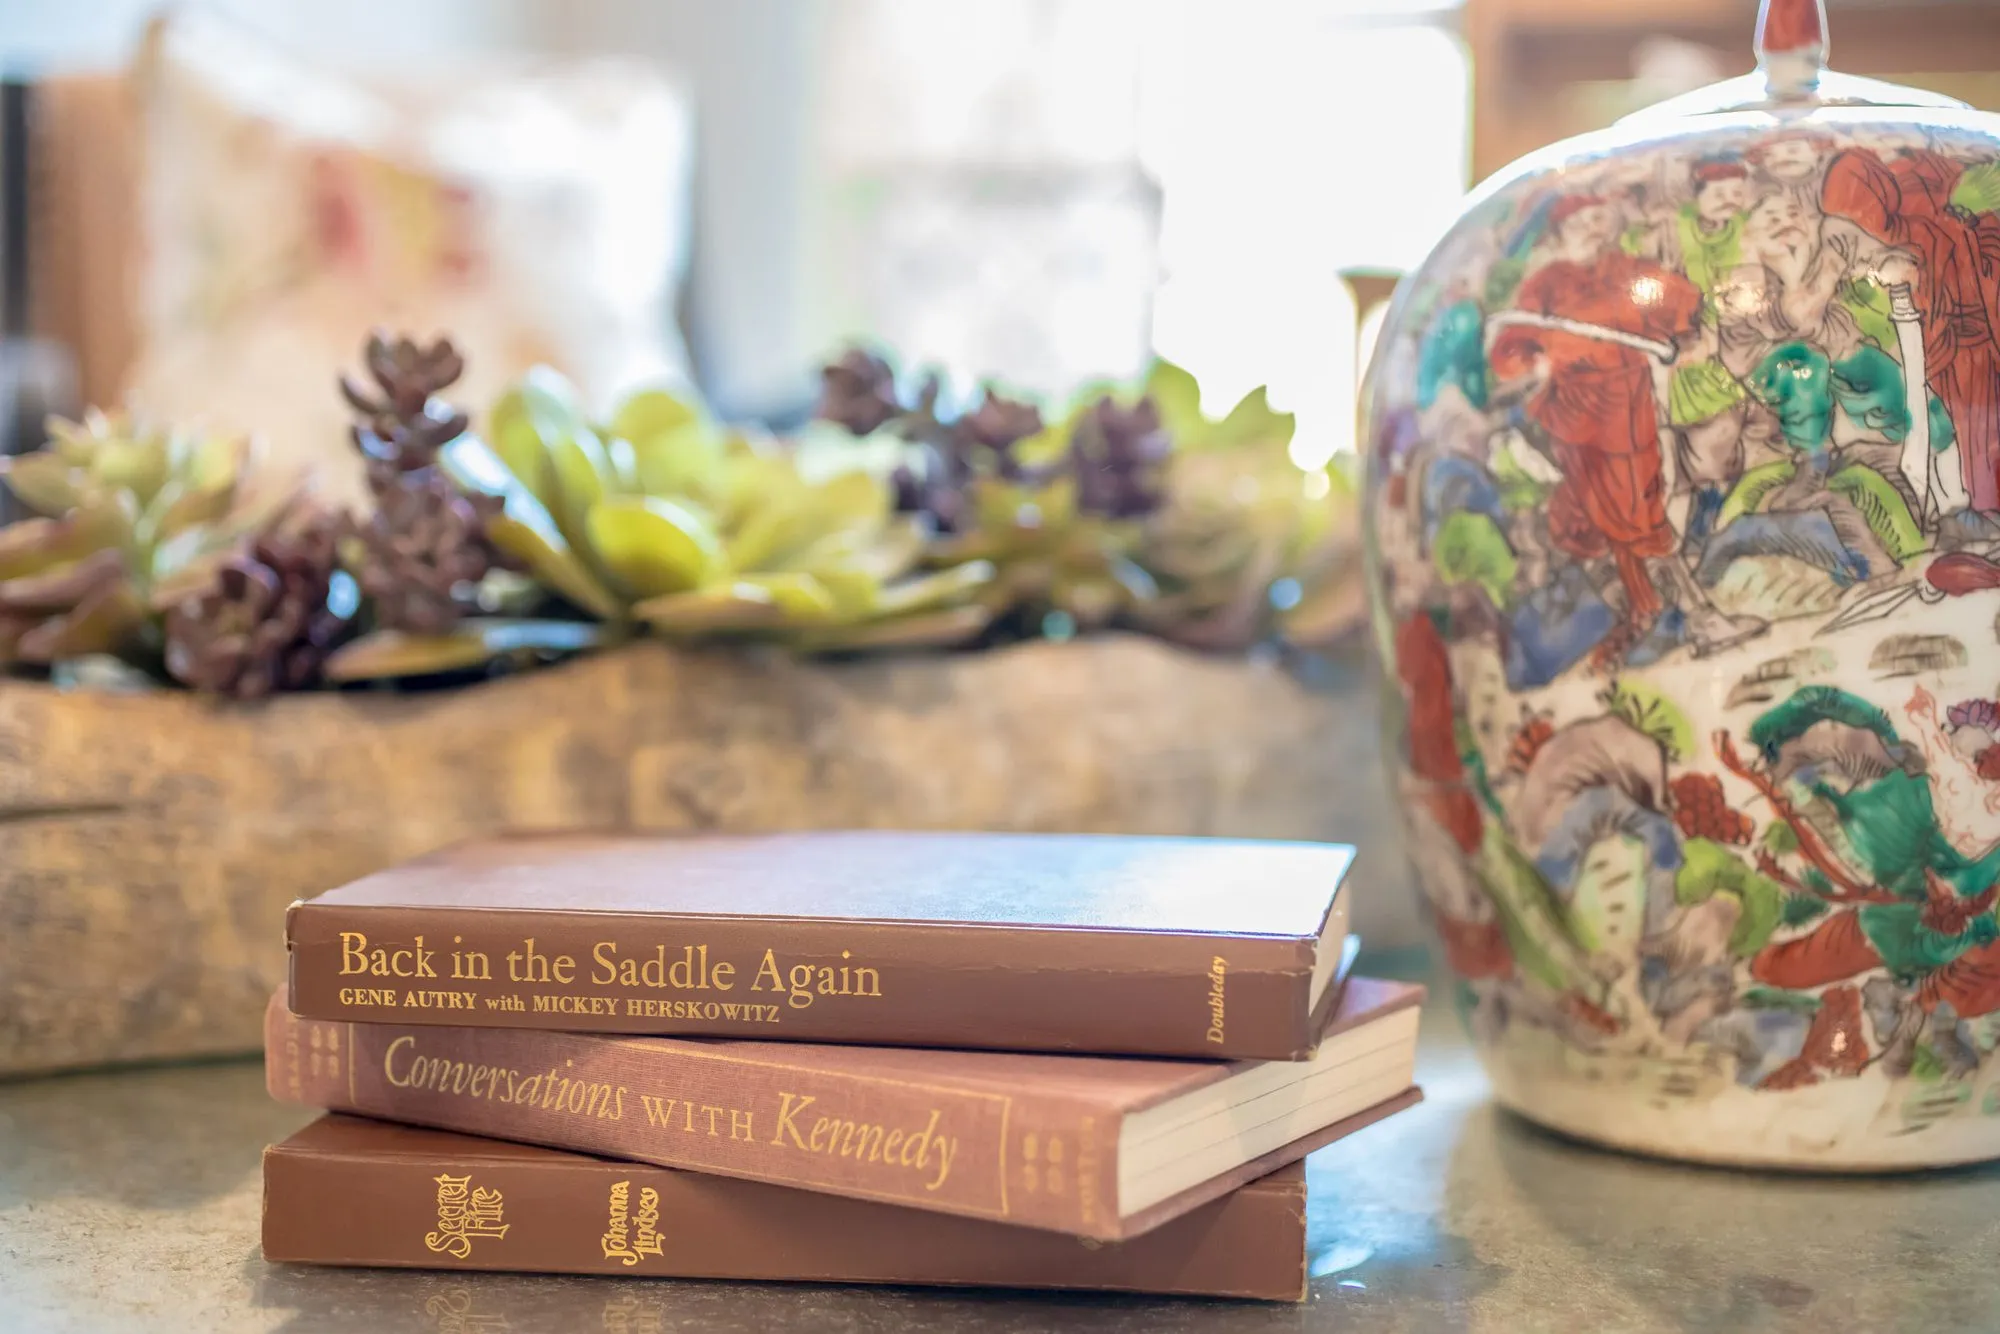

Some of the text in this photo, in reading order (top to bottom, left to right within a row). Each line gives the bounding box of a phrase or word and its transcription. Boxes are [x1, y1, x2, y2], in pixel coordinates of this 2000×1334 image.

[338, 932, 882, 1009] Back in the Saddle Again
[339, 988, 780, 1023] GENE AUTRY with MICKEY HERSKOWITZ
[1206, 955, 1230, 1044] Doubleday
[384, 1035, 958, 1190] Conversations WITH Kennedy
[425, 1173, 472, 1259] Secret
[462, 1186, 510, 1240] Fire
[601, 1180, 638, 1266] Johanna
[631, 1187, 666, 1260] Lindsey
